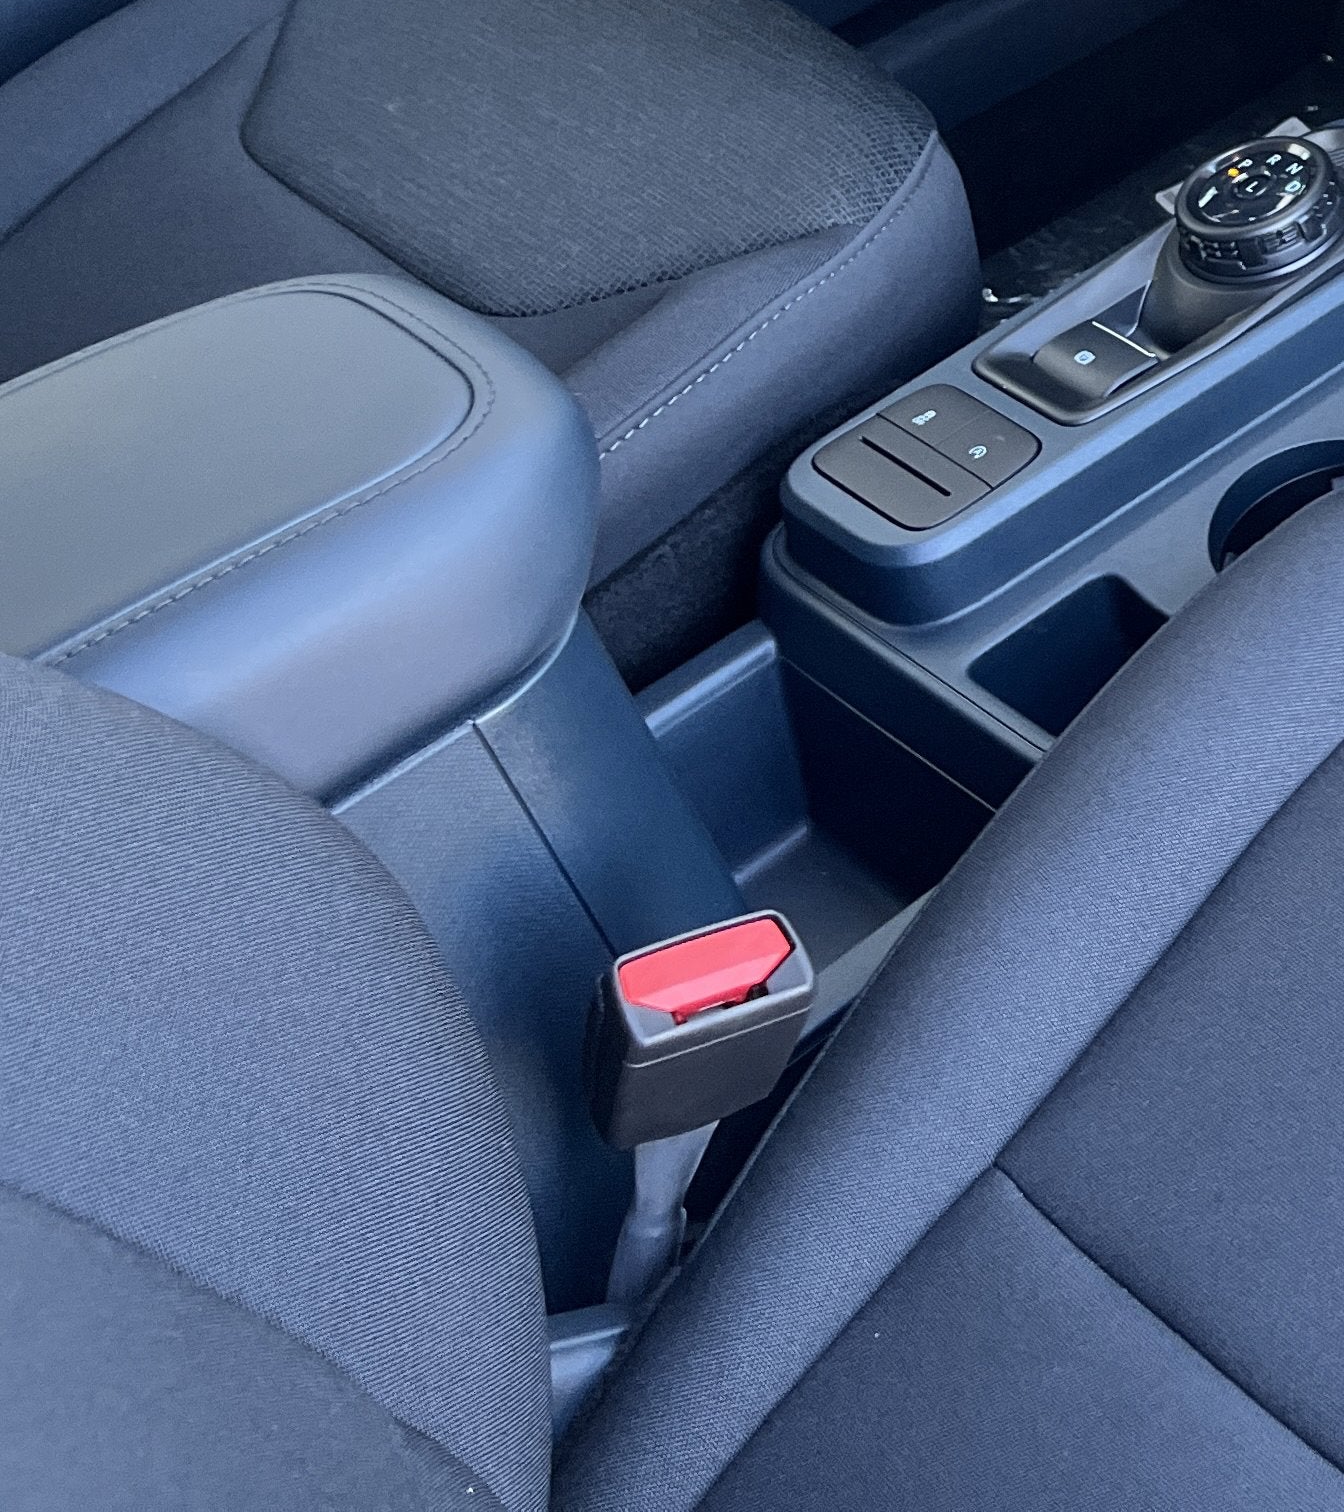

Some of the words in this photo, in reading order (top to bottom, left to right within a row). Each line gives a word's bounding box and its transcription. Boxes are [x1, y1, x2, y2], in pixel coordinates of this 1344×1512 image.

[1237, 158, 1253, 169] P
[1266, 154, 1282, 166] R
[1285, 162, 1304, 175] N
[1285, 180, 1302, 193] D
